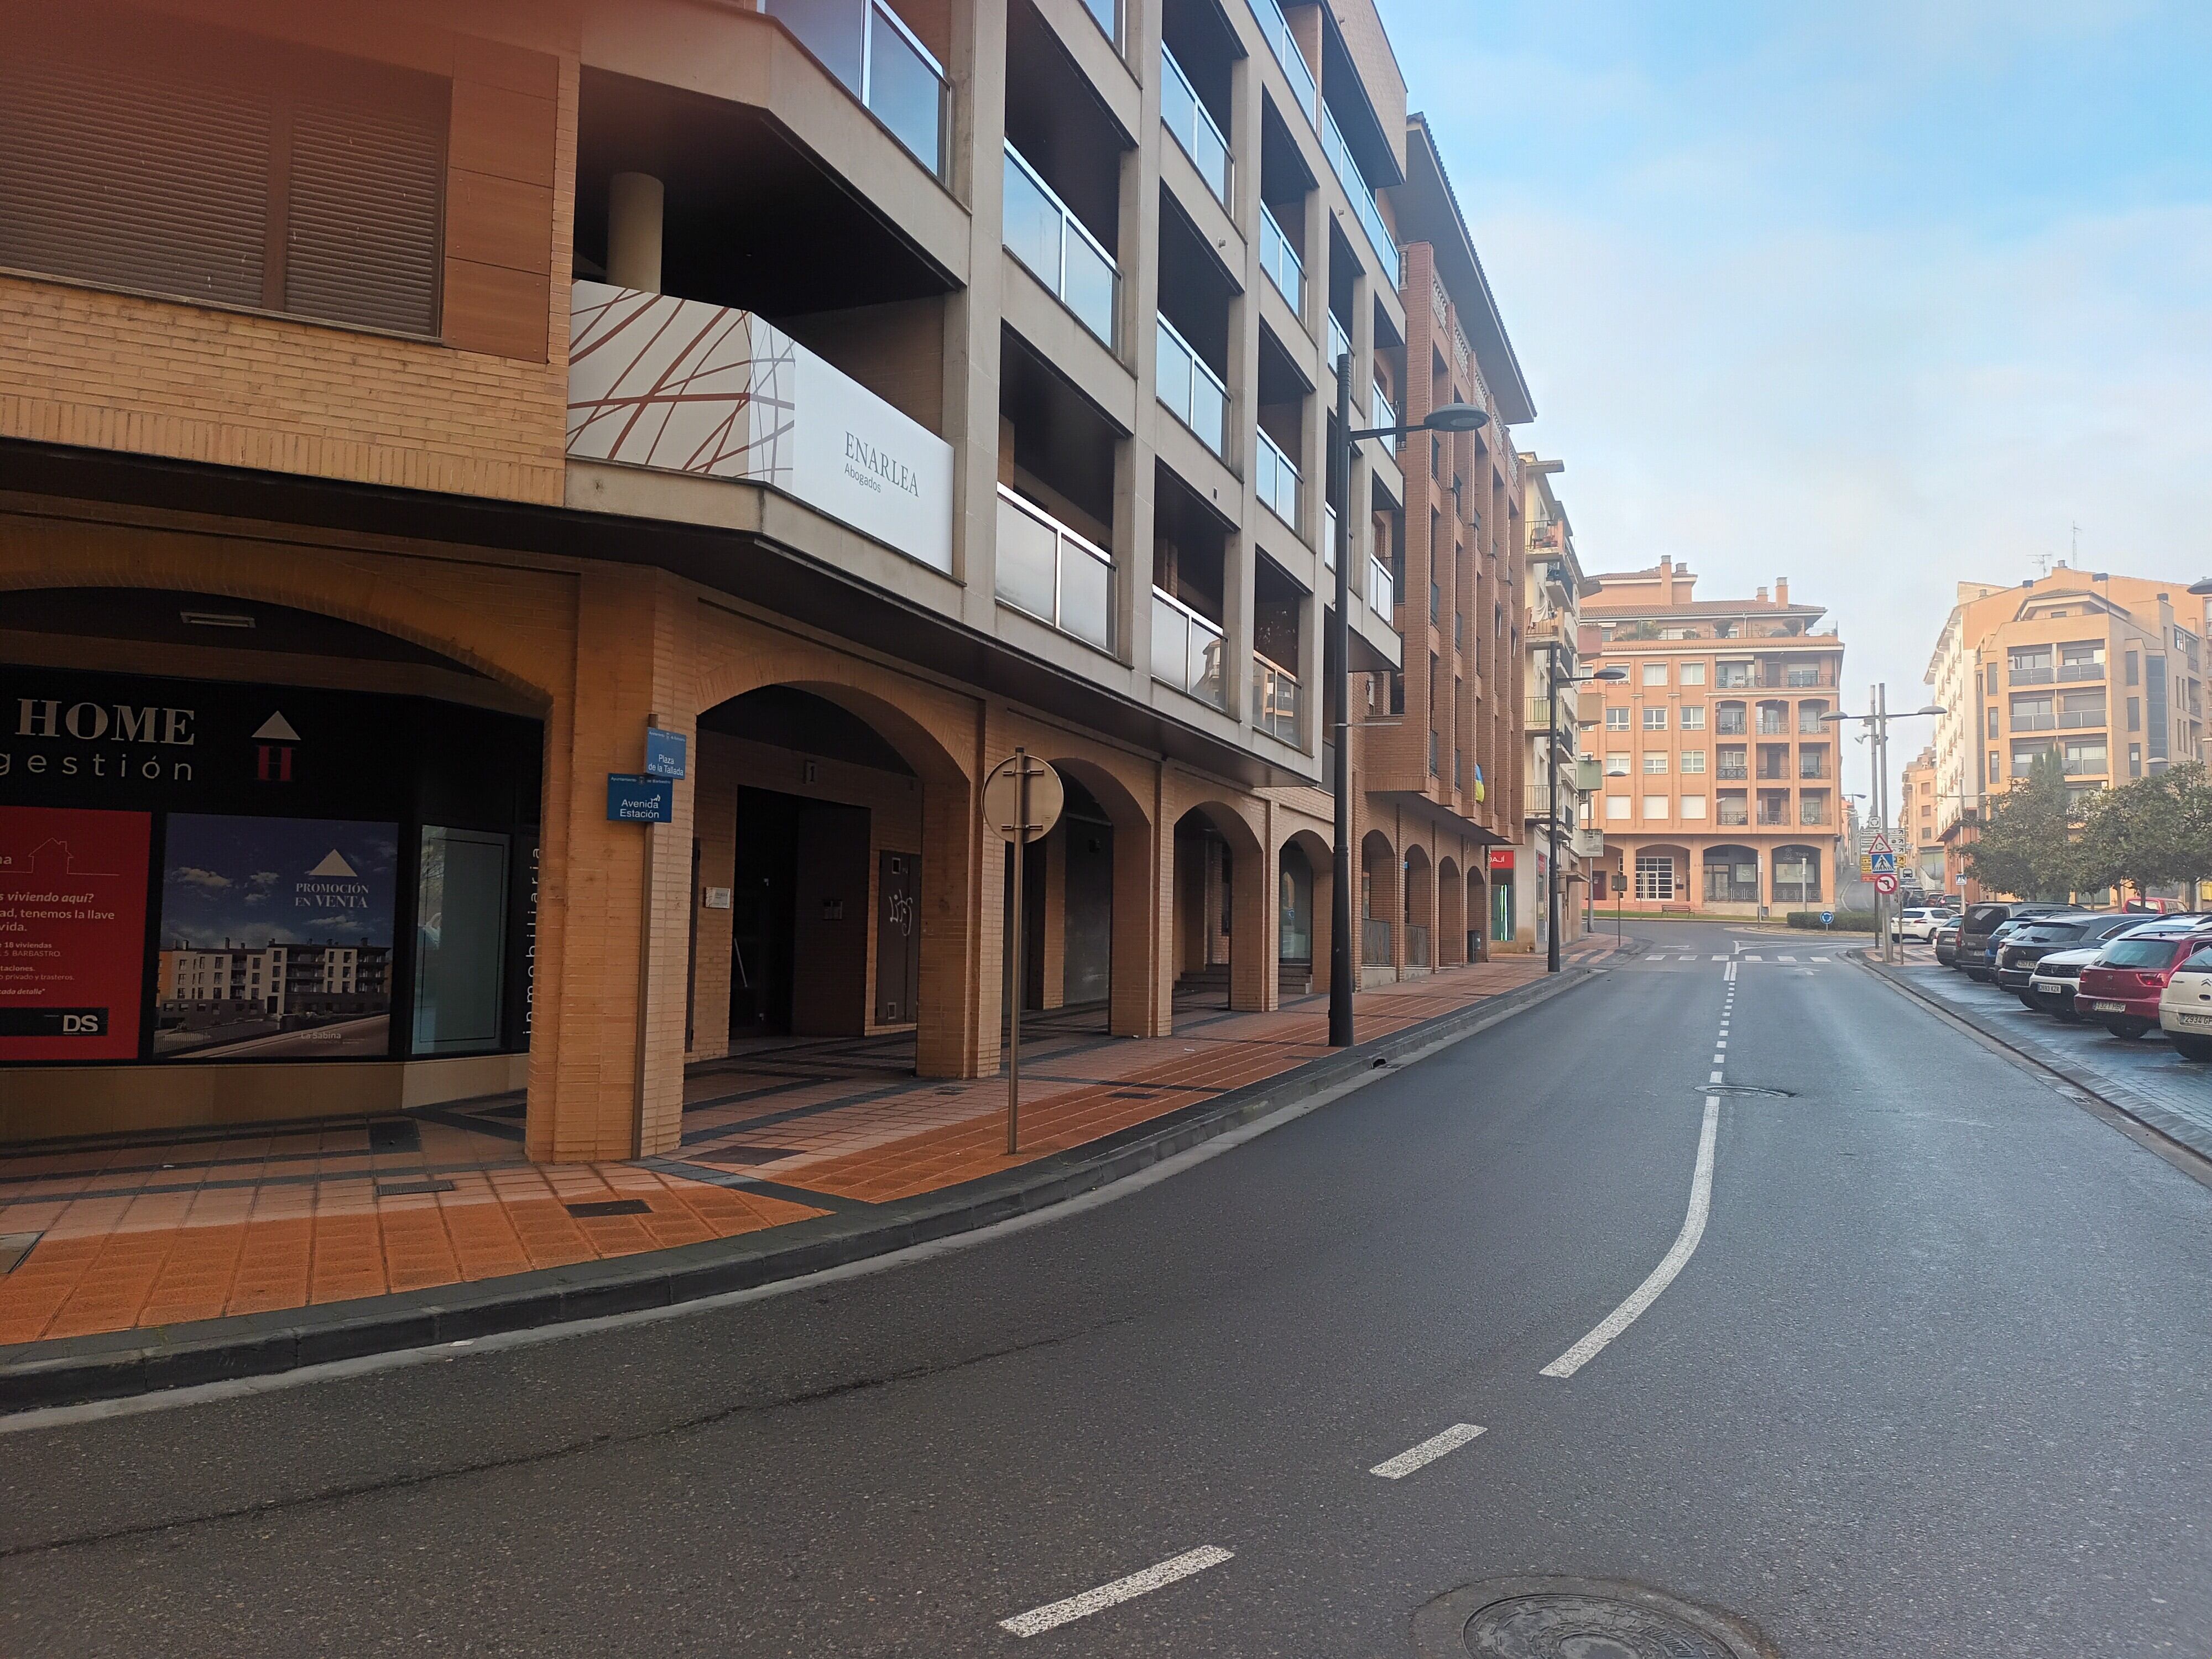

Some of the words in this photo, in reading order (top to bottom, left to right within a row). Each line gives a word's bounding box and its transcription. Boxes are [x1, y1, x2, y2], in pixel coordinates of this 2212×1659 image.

[844, 430, 919, 498] ENARLEA
[844, 463, 881, 493] Abogados
[14, 698, 195, 746] HOME
[659, 754, 675, 764] Plaza
[648, 762, 656, 771] de
[658, 764, 662, 772] la
[664, 765, 684, 776] Tallada
[621, 799, 659, 808] Avenida
[620, 808, 659, 818] Estación
[296, 882, 369, 894] PROMOCIÓN
[8, 891, 59, 902] viviendo
[61, 893, 94, 904] aquí?
[295, 896, 311, 906] EN
[315, 894, 369, 908] VENTA
[20, 909, 71, 918] tenemos
[75, 910, 85, 919] la
[87, 910, 114, 920] llave
[63, 1015, 98, 1032] DS
[2185, 1015, 2202, 1023] 2934
